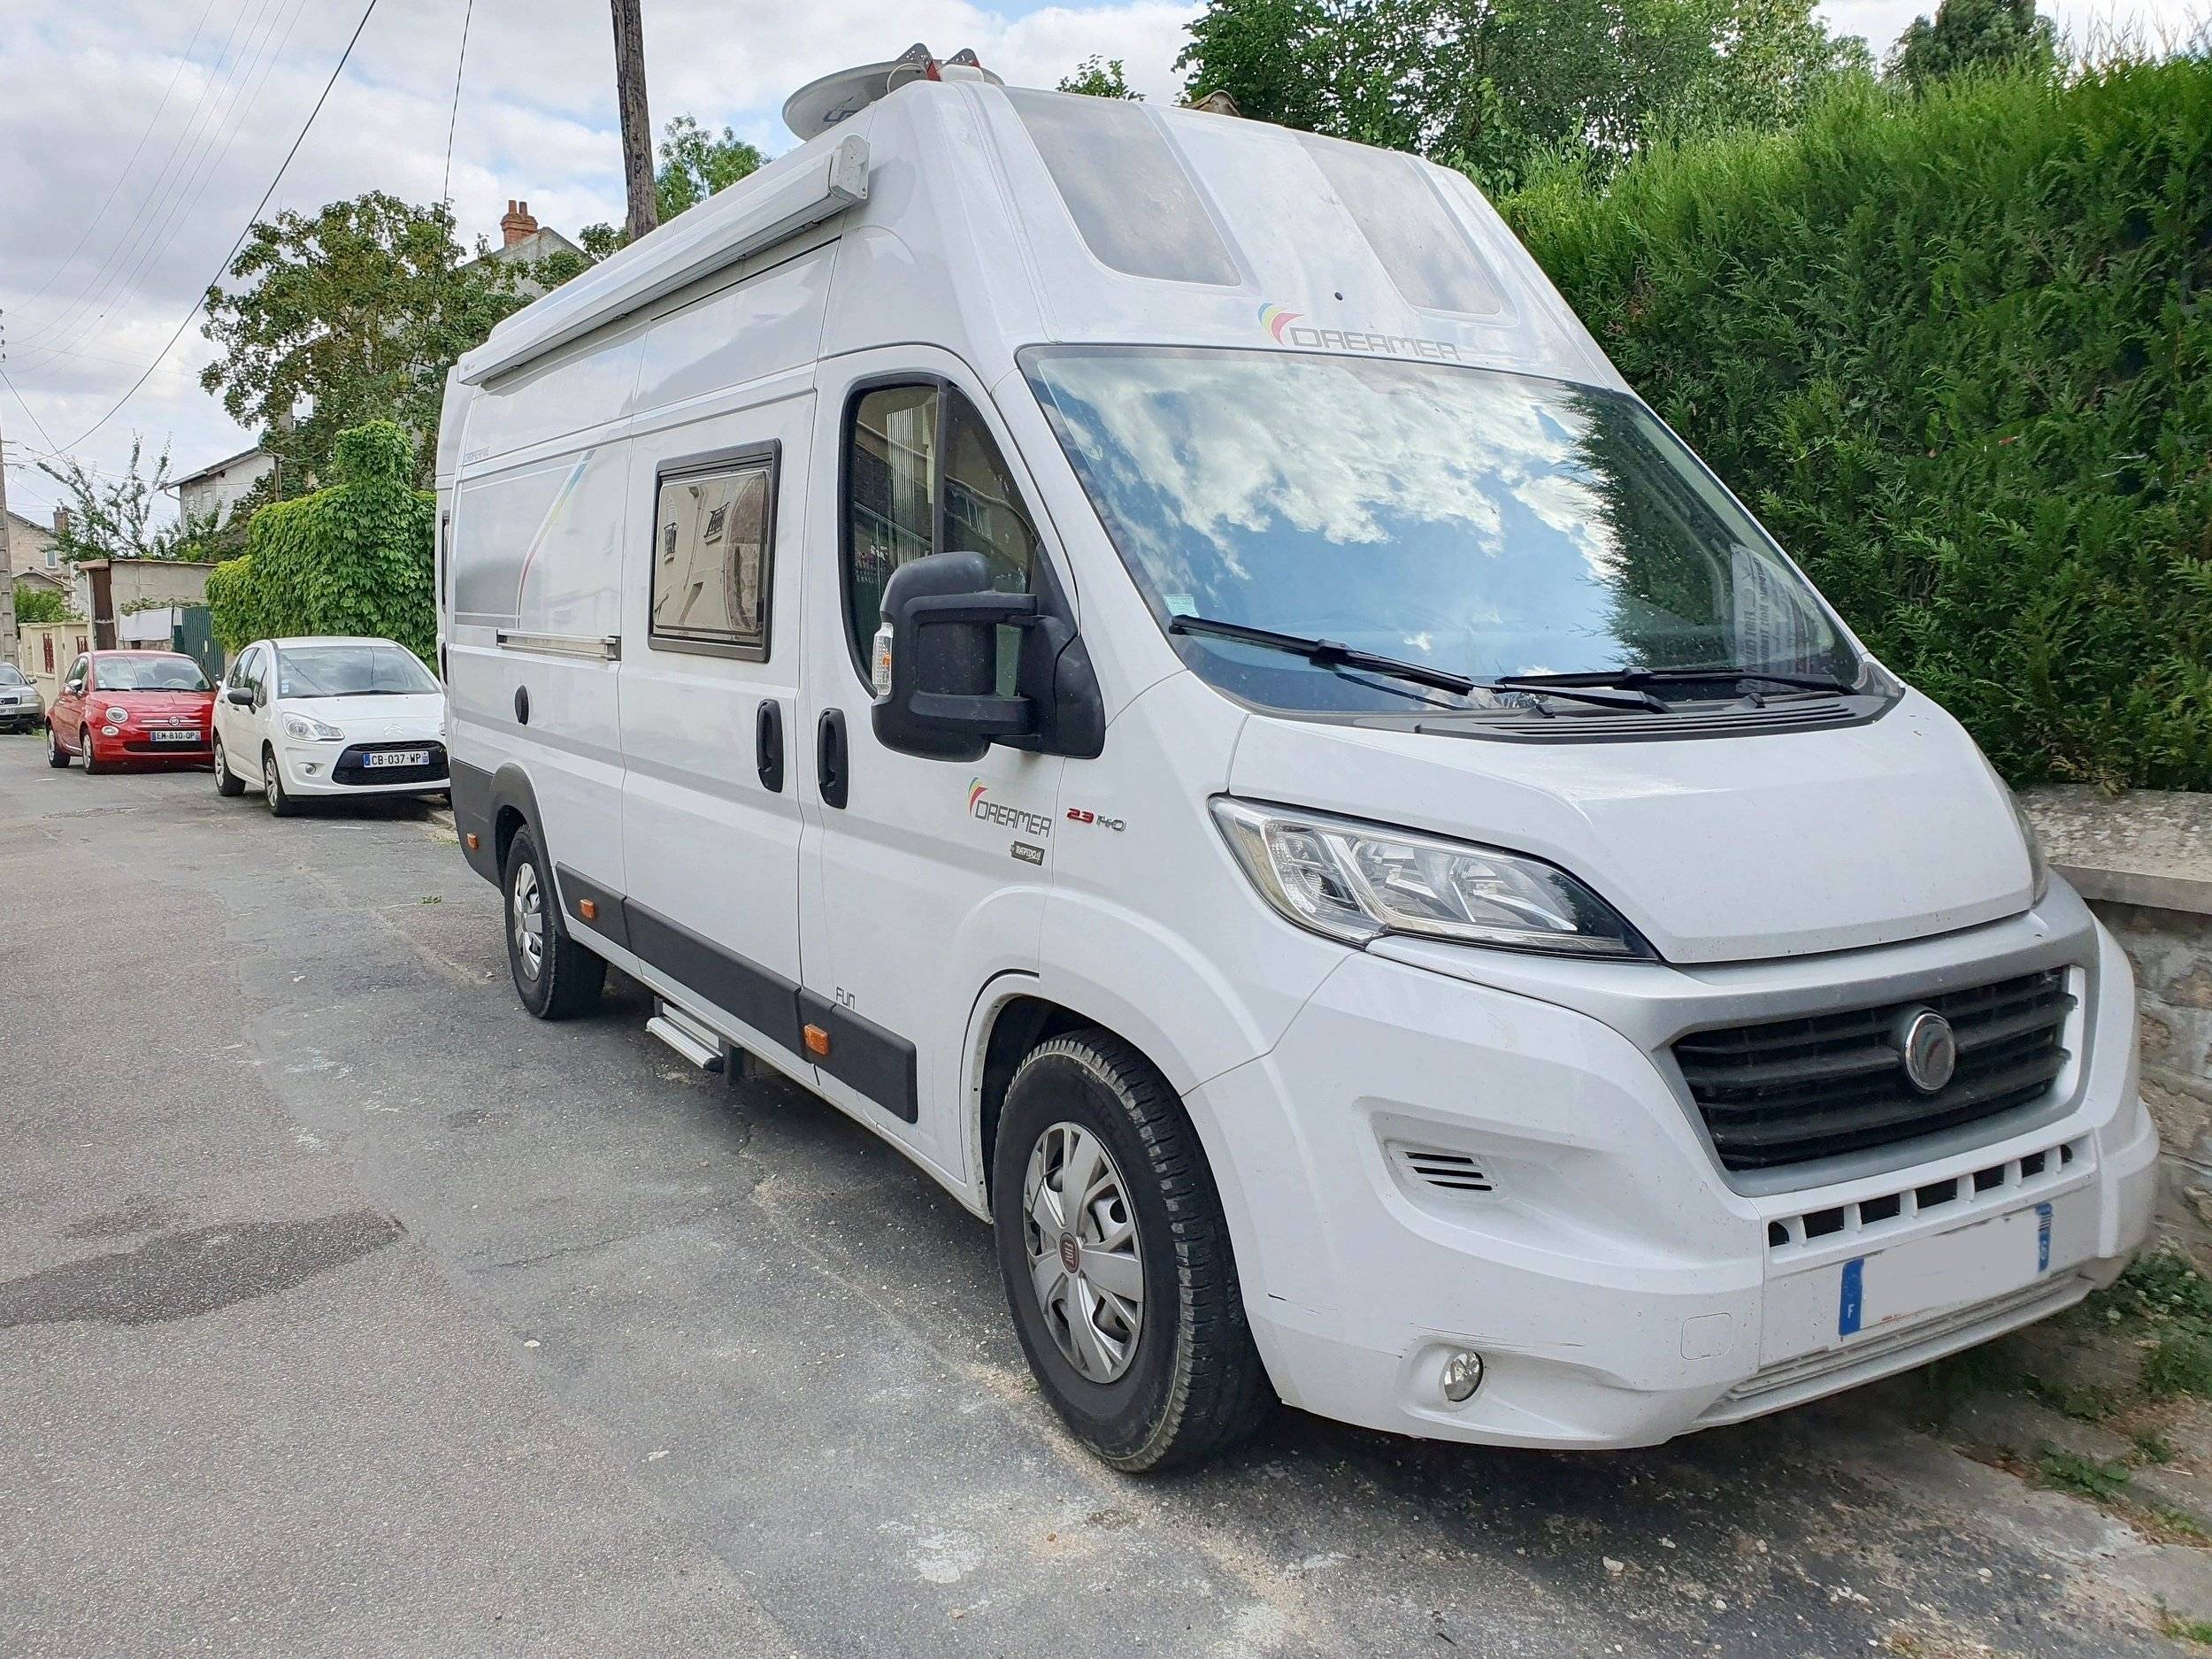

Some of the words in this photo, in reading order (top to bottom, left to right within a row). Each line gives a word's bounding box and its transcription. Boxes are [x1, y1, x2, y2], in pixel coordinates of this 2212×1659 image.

[1289, 326, 1461, 361] DREAMER
[975, 800, 1052, 838] DREAMER
[1096, 814, 1127, 832] 140
[836, 986, 856, 1010] FUN
[1064, 1240, 1075, 1266] FIAT
